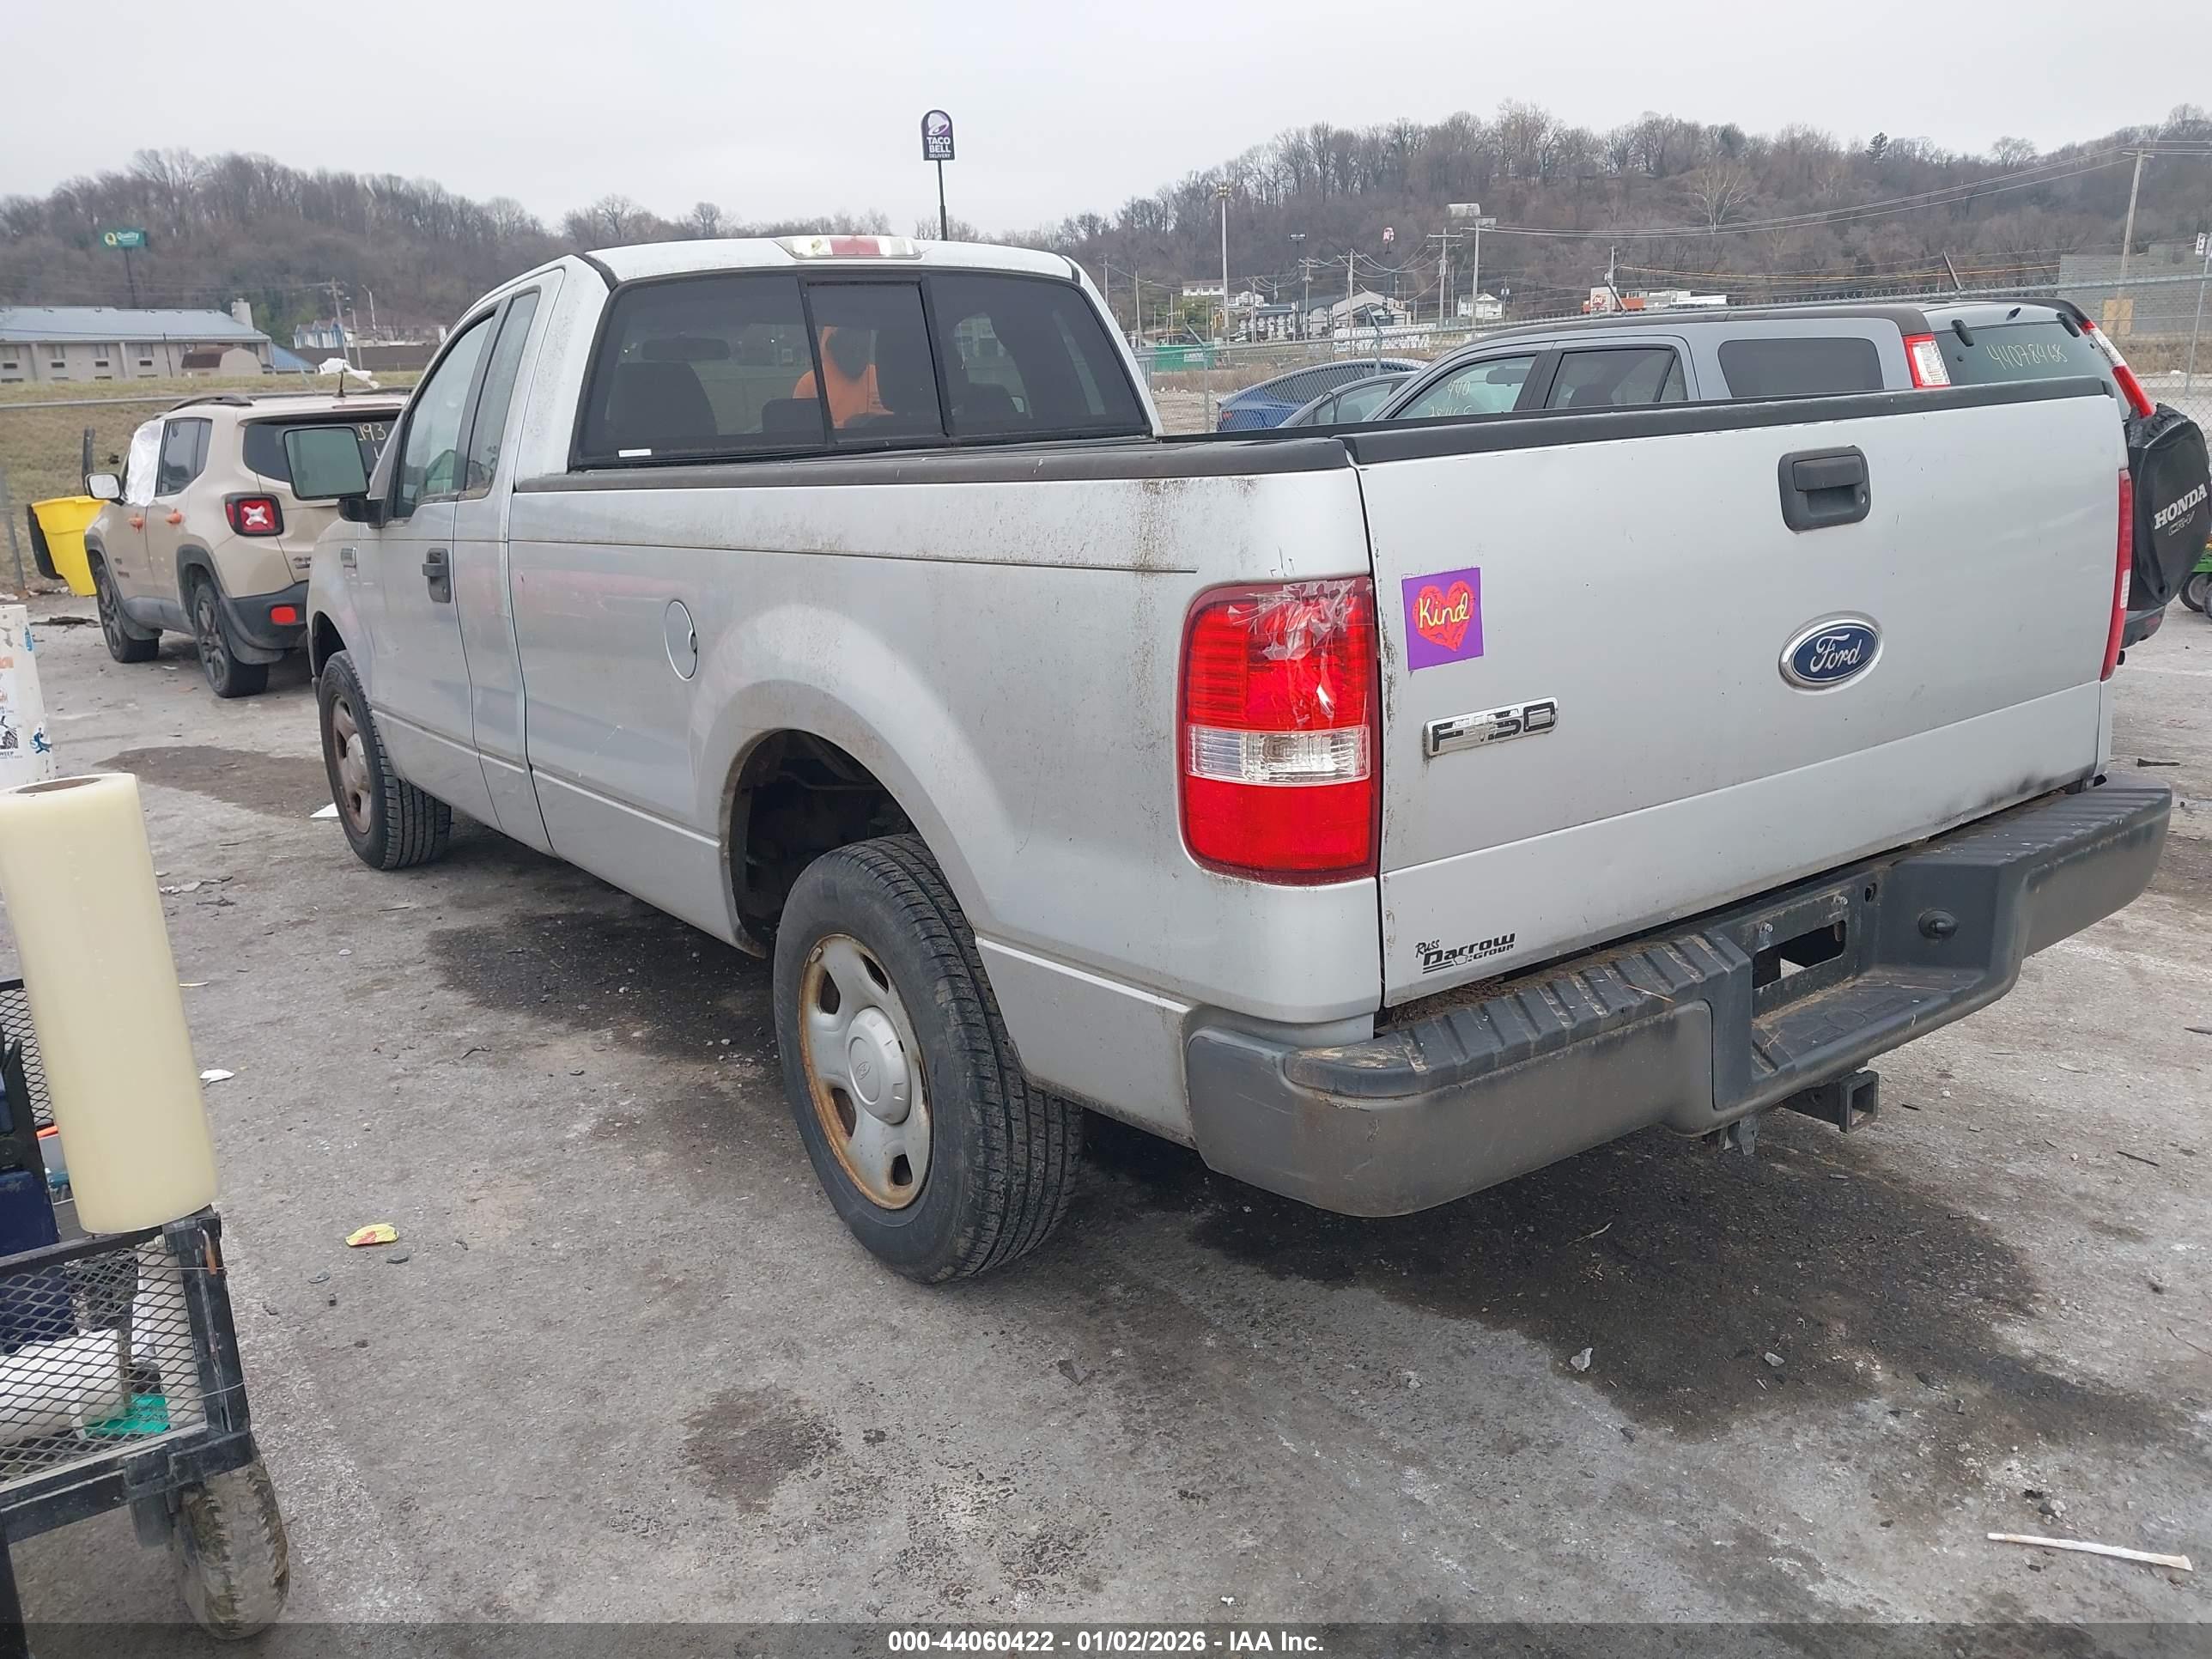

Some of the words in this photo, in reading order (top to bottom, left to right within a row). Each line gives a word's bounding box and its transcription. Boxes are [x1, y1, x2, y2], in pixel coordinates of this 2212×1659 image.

[926, 136, 951, 145] TACO
[928, 144, 952, 153] BELL
[116, 231, 139, 241] Quality
[2154, 483, 2208, 530] HONDA
[1419, 592, 1470, 629] Kind
[1809, 634, 1863, 673] Ford
[1422, 933, 1516, 967] Darrow
